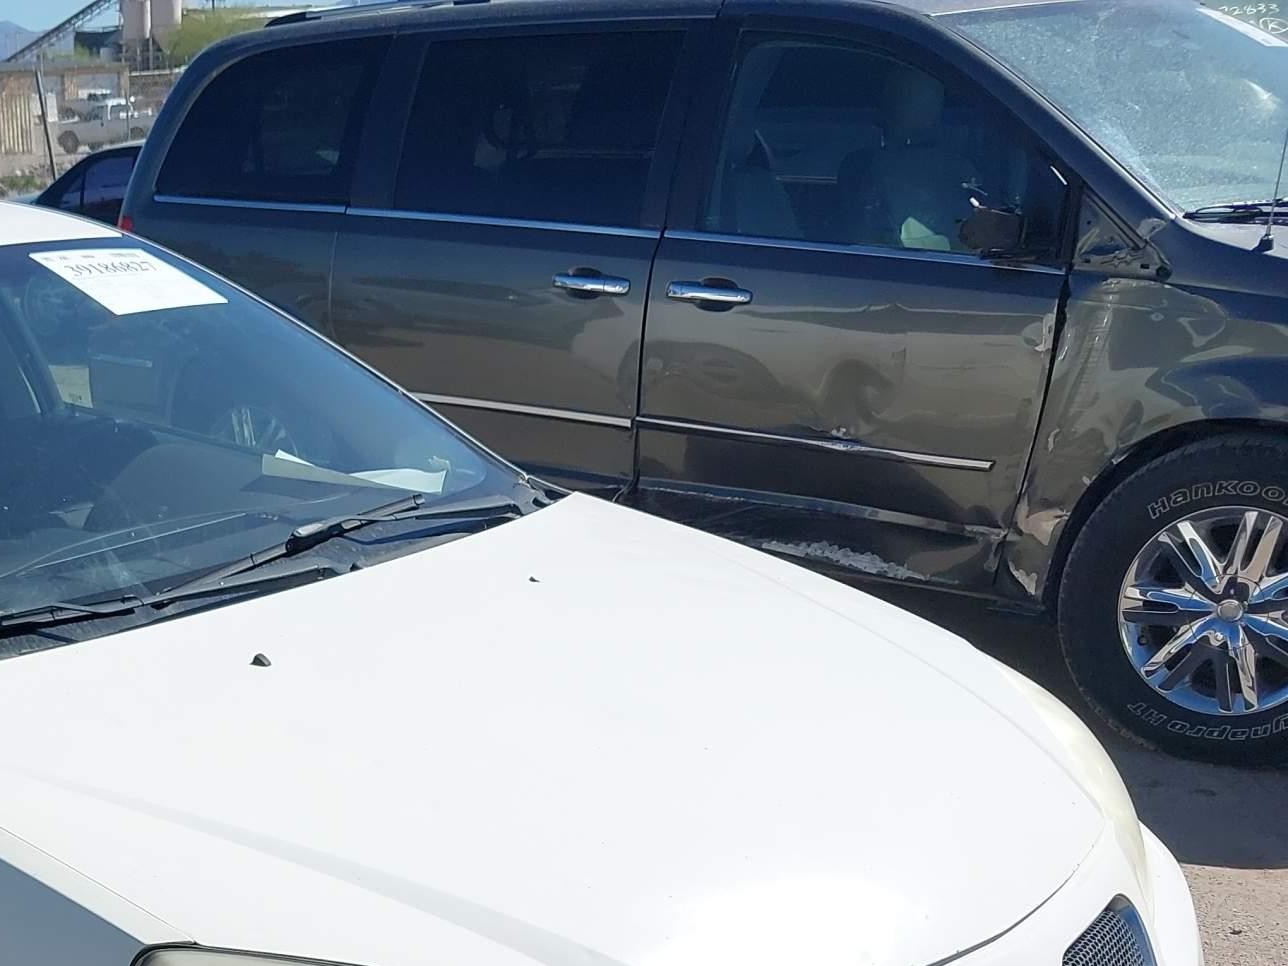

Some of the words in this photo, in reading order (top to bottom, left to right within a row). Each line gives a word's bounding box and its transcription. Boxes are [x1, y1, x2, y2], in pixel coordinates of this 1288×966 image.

[62, 260, 157, 276] 39186827
[1148, 480, 1288, 519] Hankoo
[1127, 701, 1167, 727] HT
